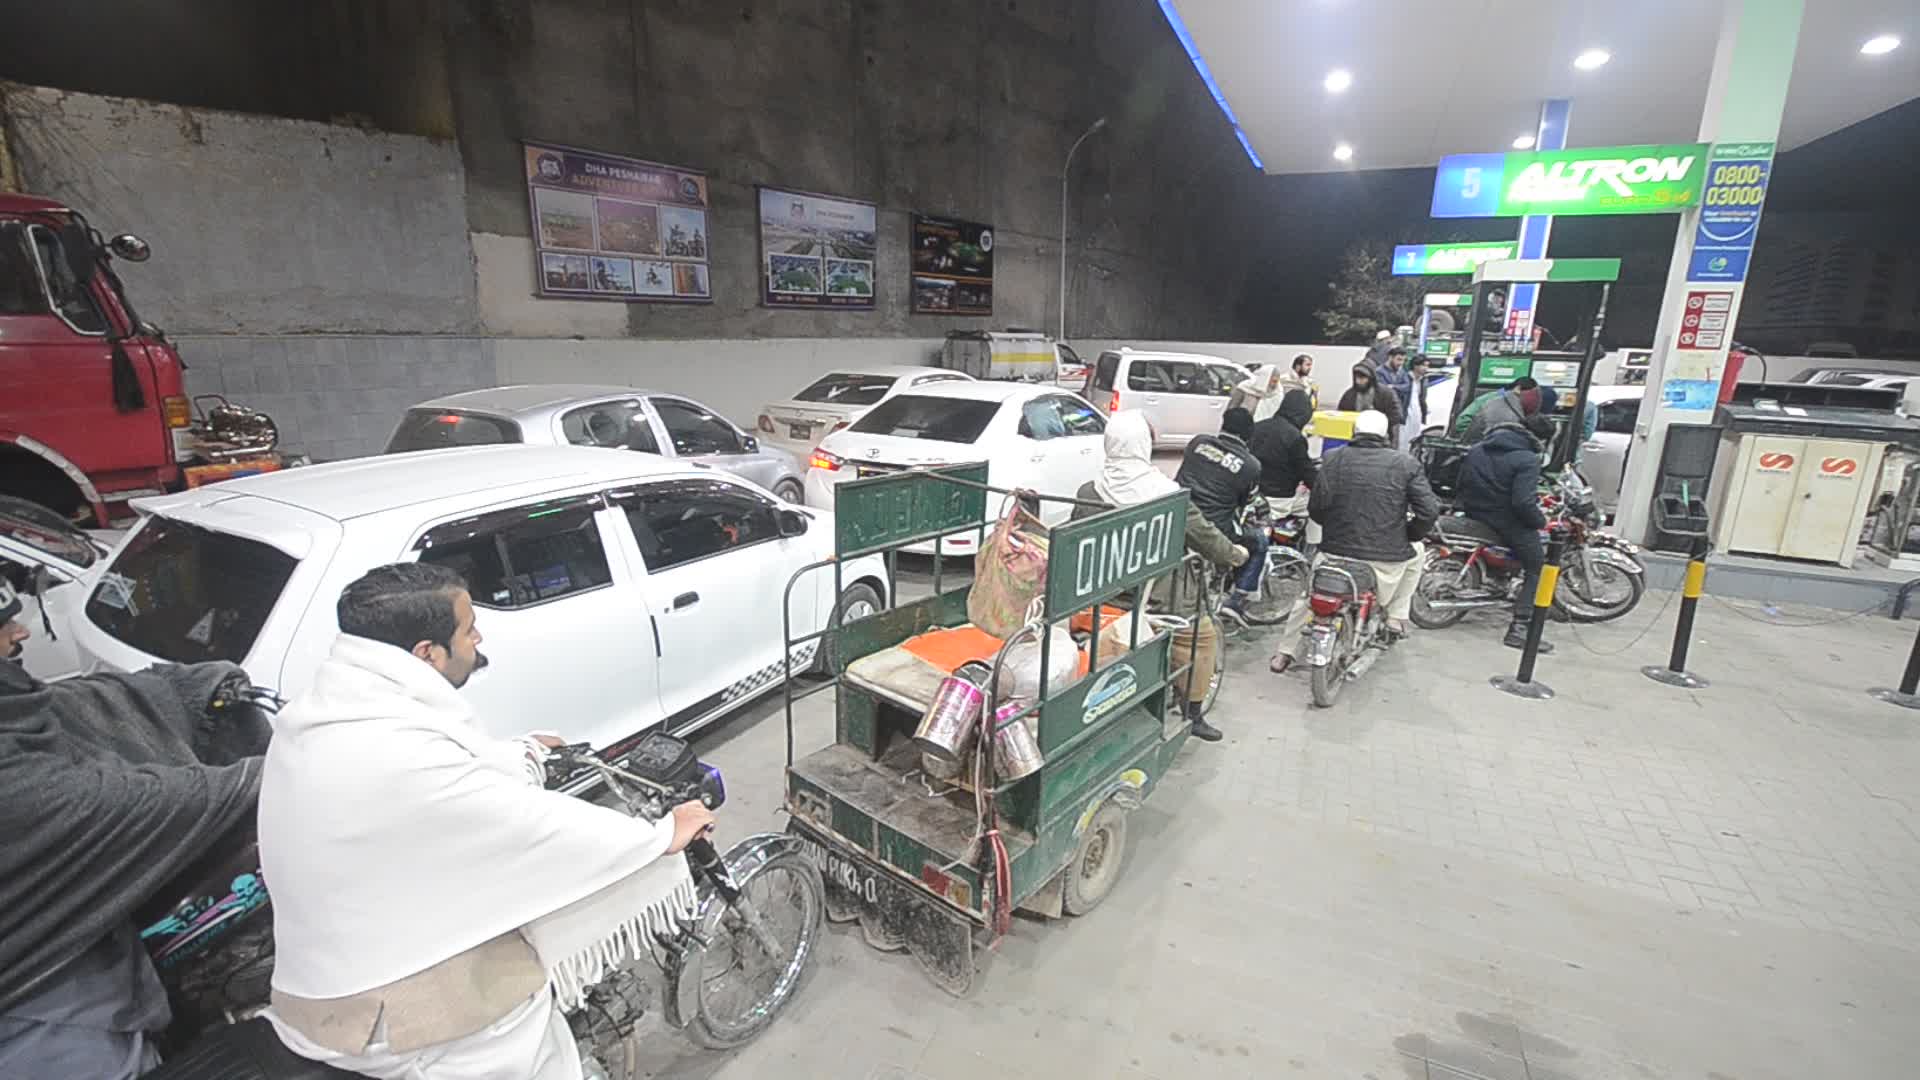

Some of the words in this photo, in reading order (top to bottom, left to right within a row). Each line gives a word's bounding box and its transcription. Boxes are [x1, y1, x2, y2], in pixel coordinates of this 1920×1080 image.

[1461, 167, 1482, 198] 5
[1512, 156, 1696, 199] ALTRON
[1706, 186, 1761, 206] 03000
[1076, 511, 1173, 596] QINGQI
